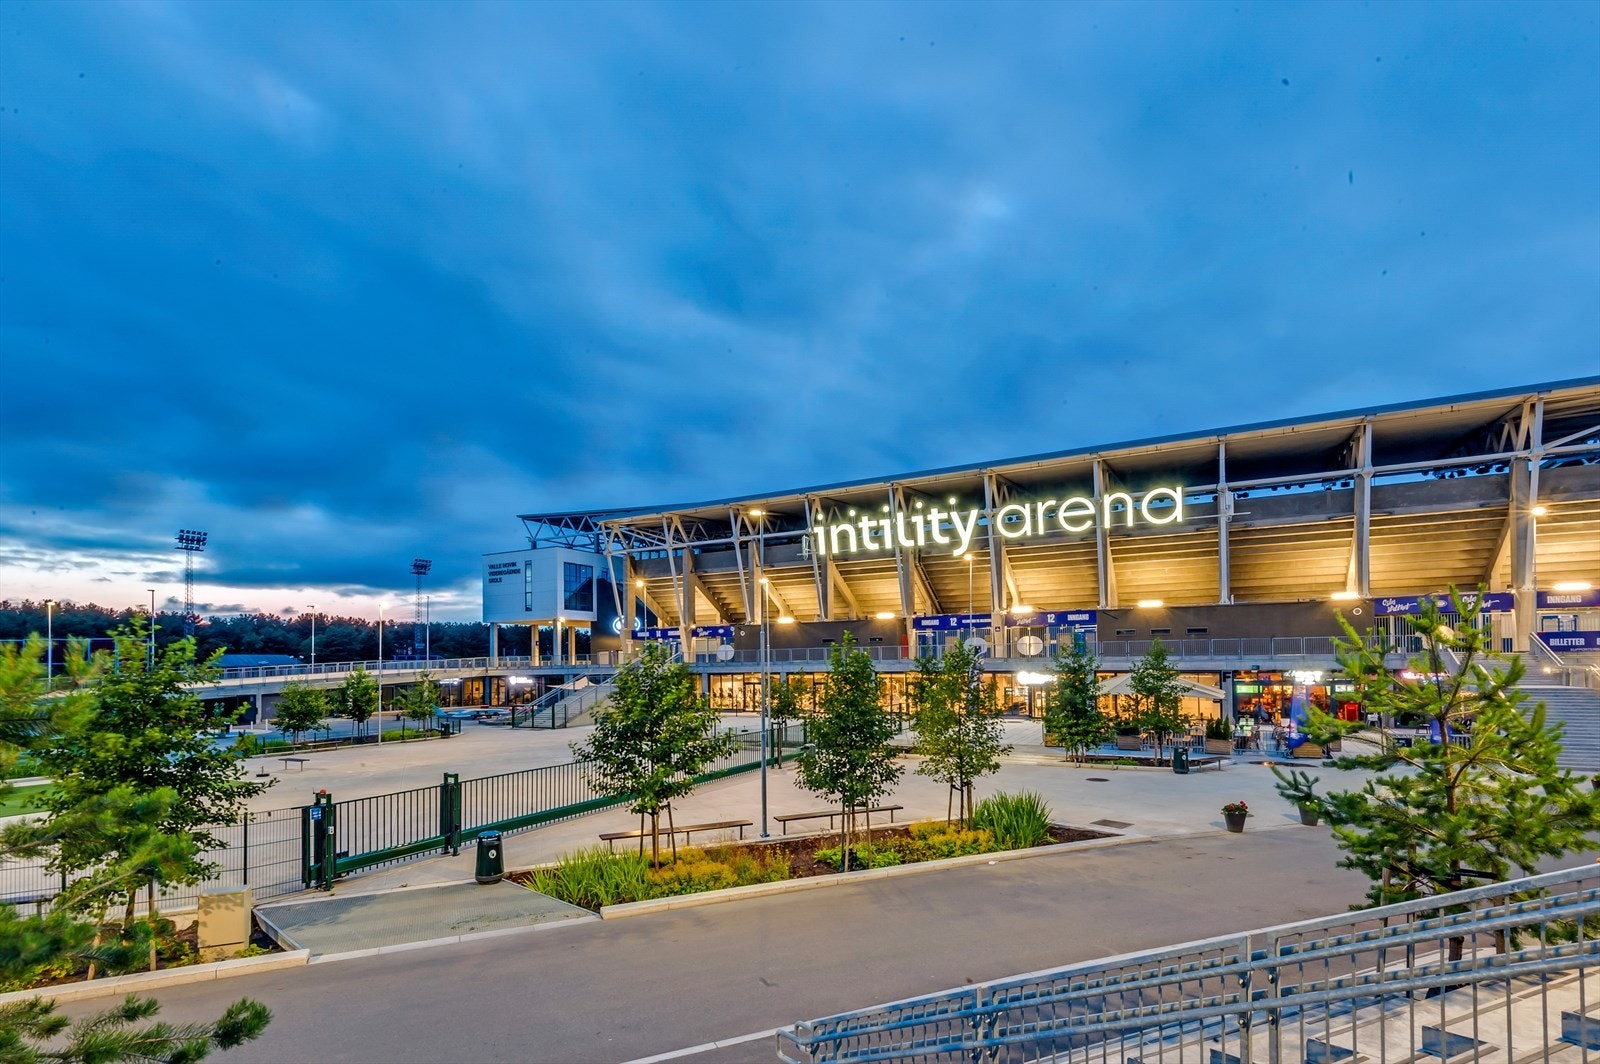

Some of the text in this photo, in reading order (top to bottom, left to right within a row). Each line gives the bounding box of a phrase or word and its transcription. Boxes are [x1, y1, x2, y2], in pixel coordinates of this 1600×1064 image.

[814, 486, 1184, 557] intility arena
[1546, 595, 1582, 604] INNGANG
[949, 617, 958, 627] 12
[1046, 613, 1056, 623] 12
[1549, 637, 1585, 646] BILLETTER
